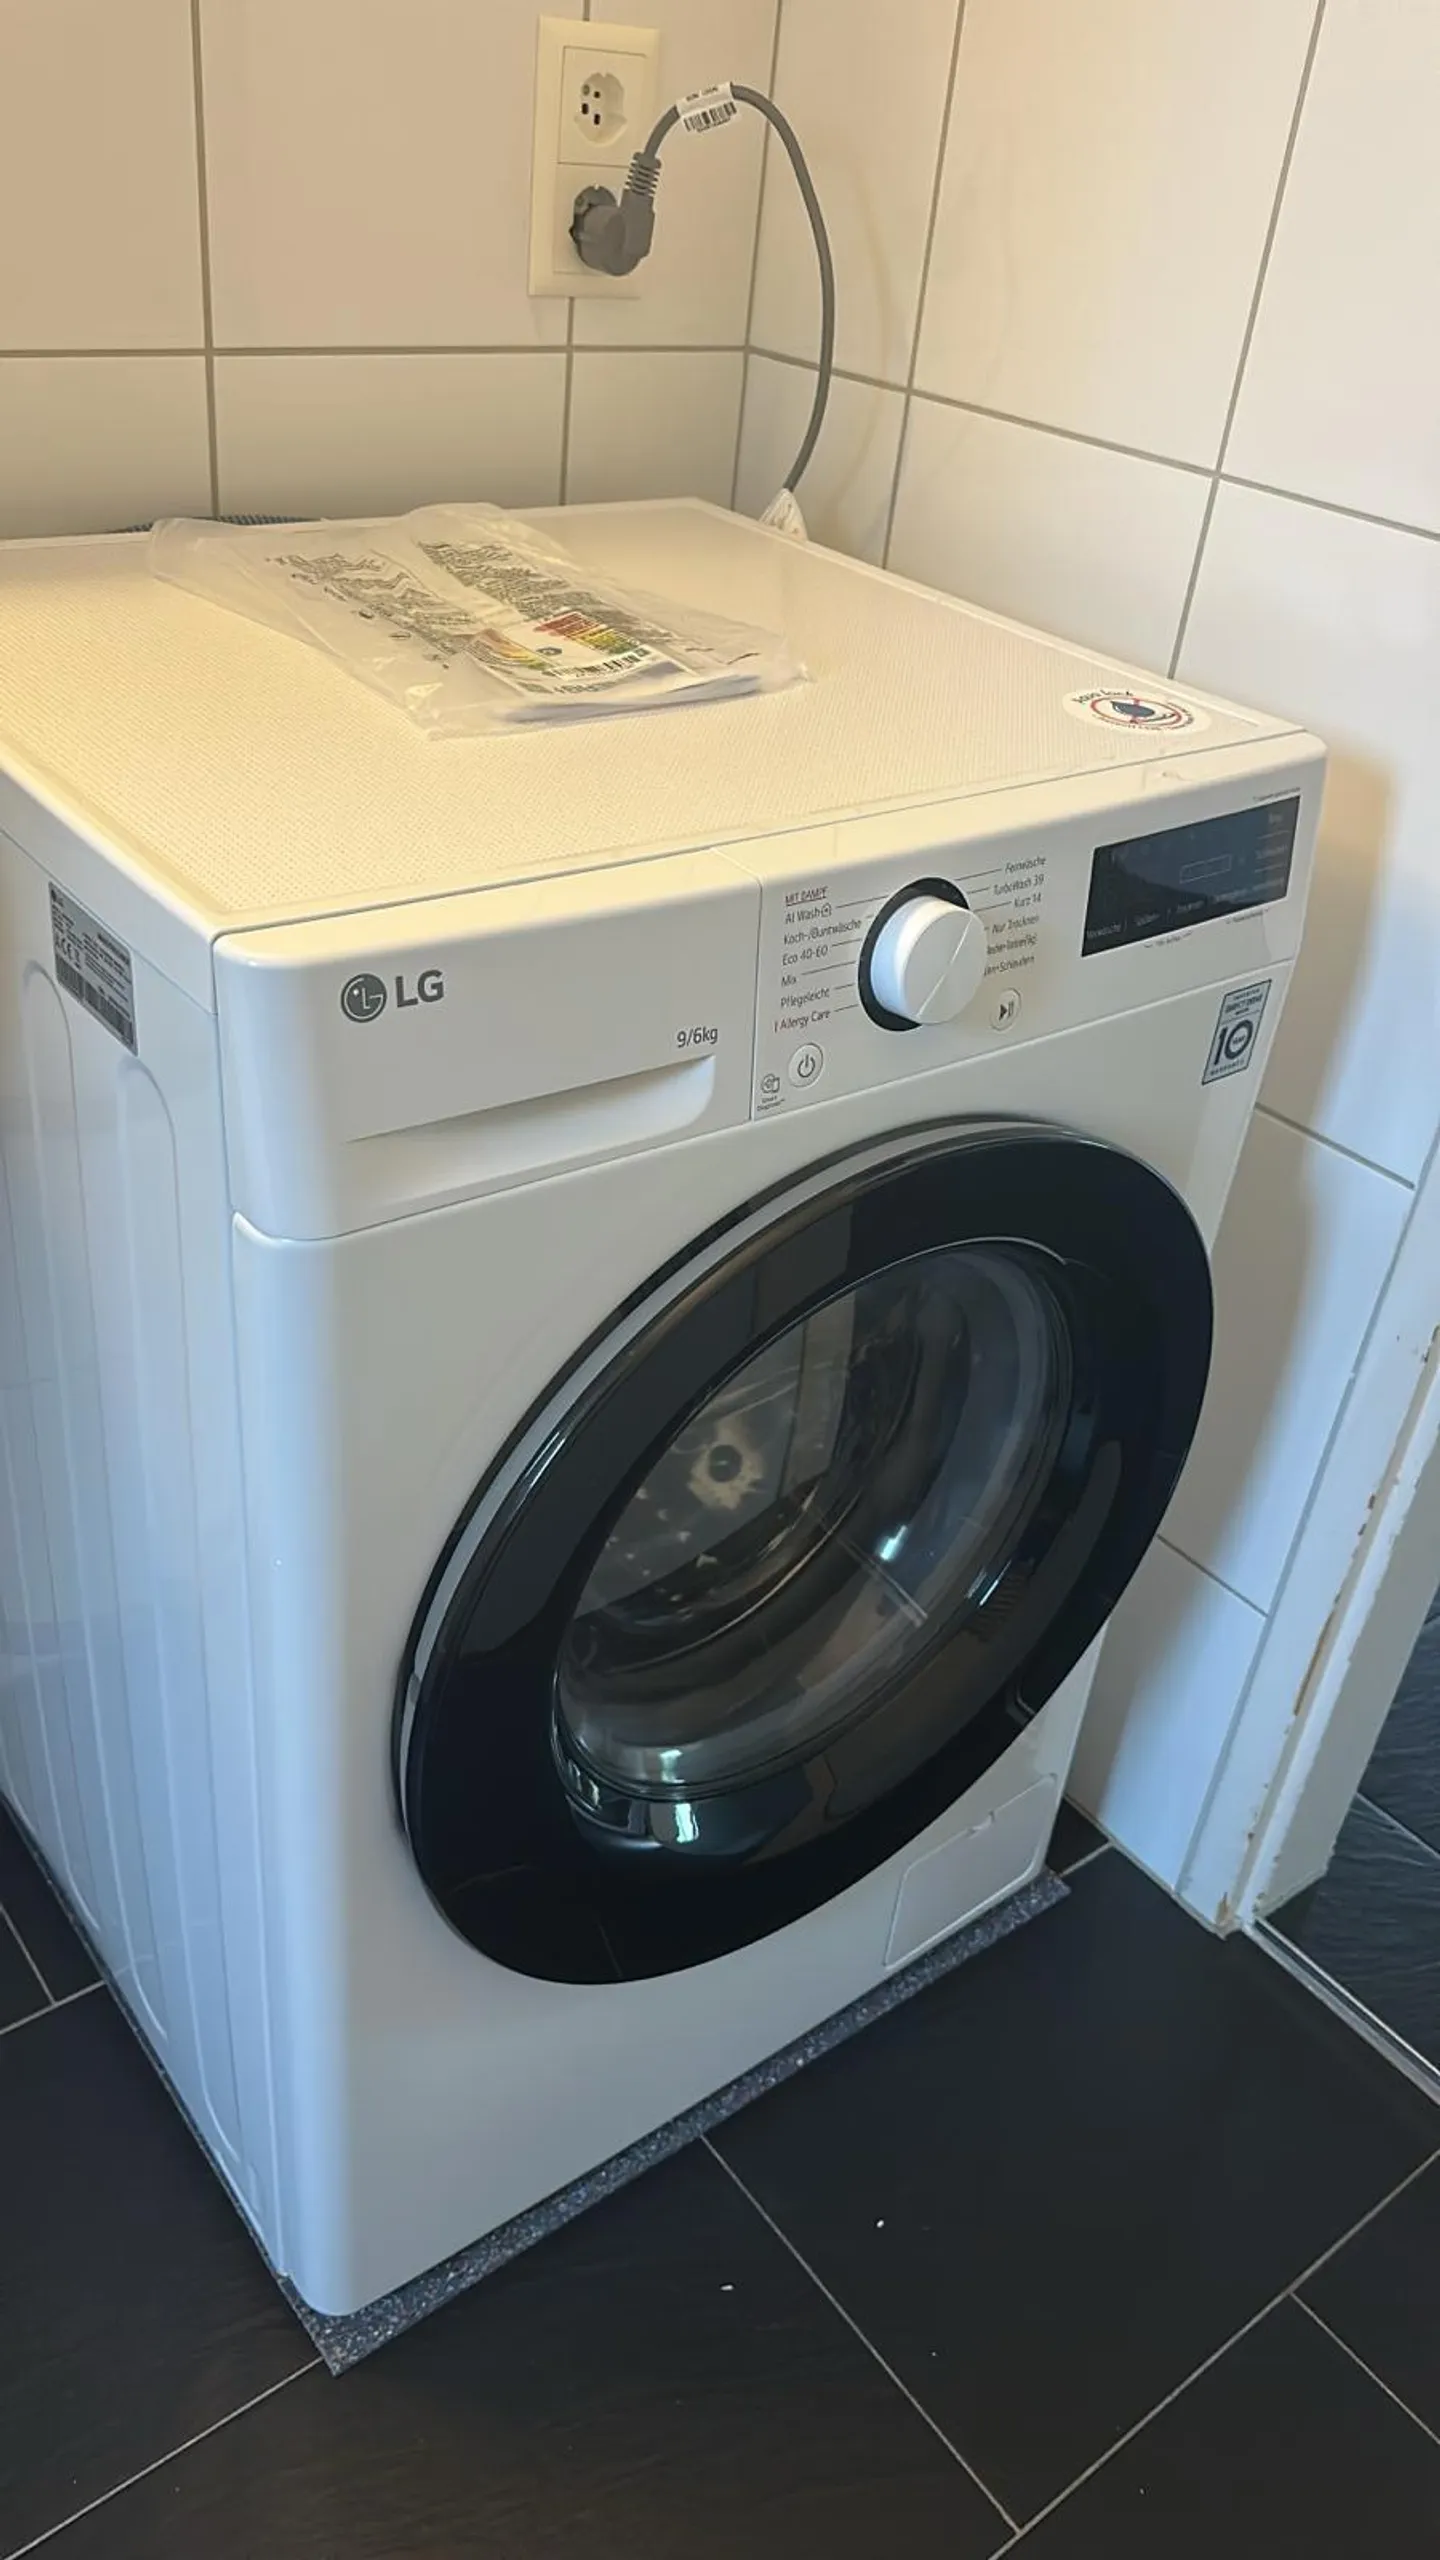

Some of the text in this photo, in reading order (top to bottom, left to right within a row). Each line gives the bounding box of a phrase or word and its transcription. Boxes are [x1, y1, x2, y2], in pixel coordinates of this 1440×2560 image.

[785, 907, 821, 924] AI Wash
[782, 945, 829, 966] Eco 40-60
[393, 969, 444, 1008] LG
[781, 975, 798, 987] Mix
[779, 1010, 832, 1029] Allergy Care
[677, 1026, 718, 1048] 9/6kg
